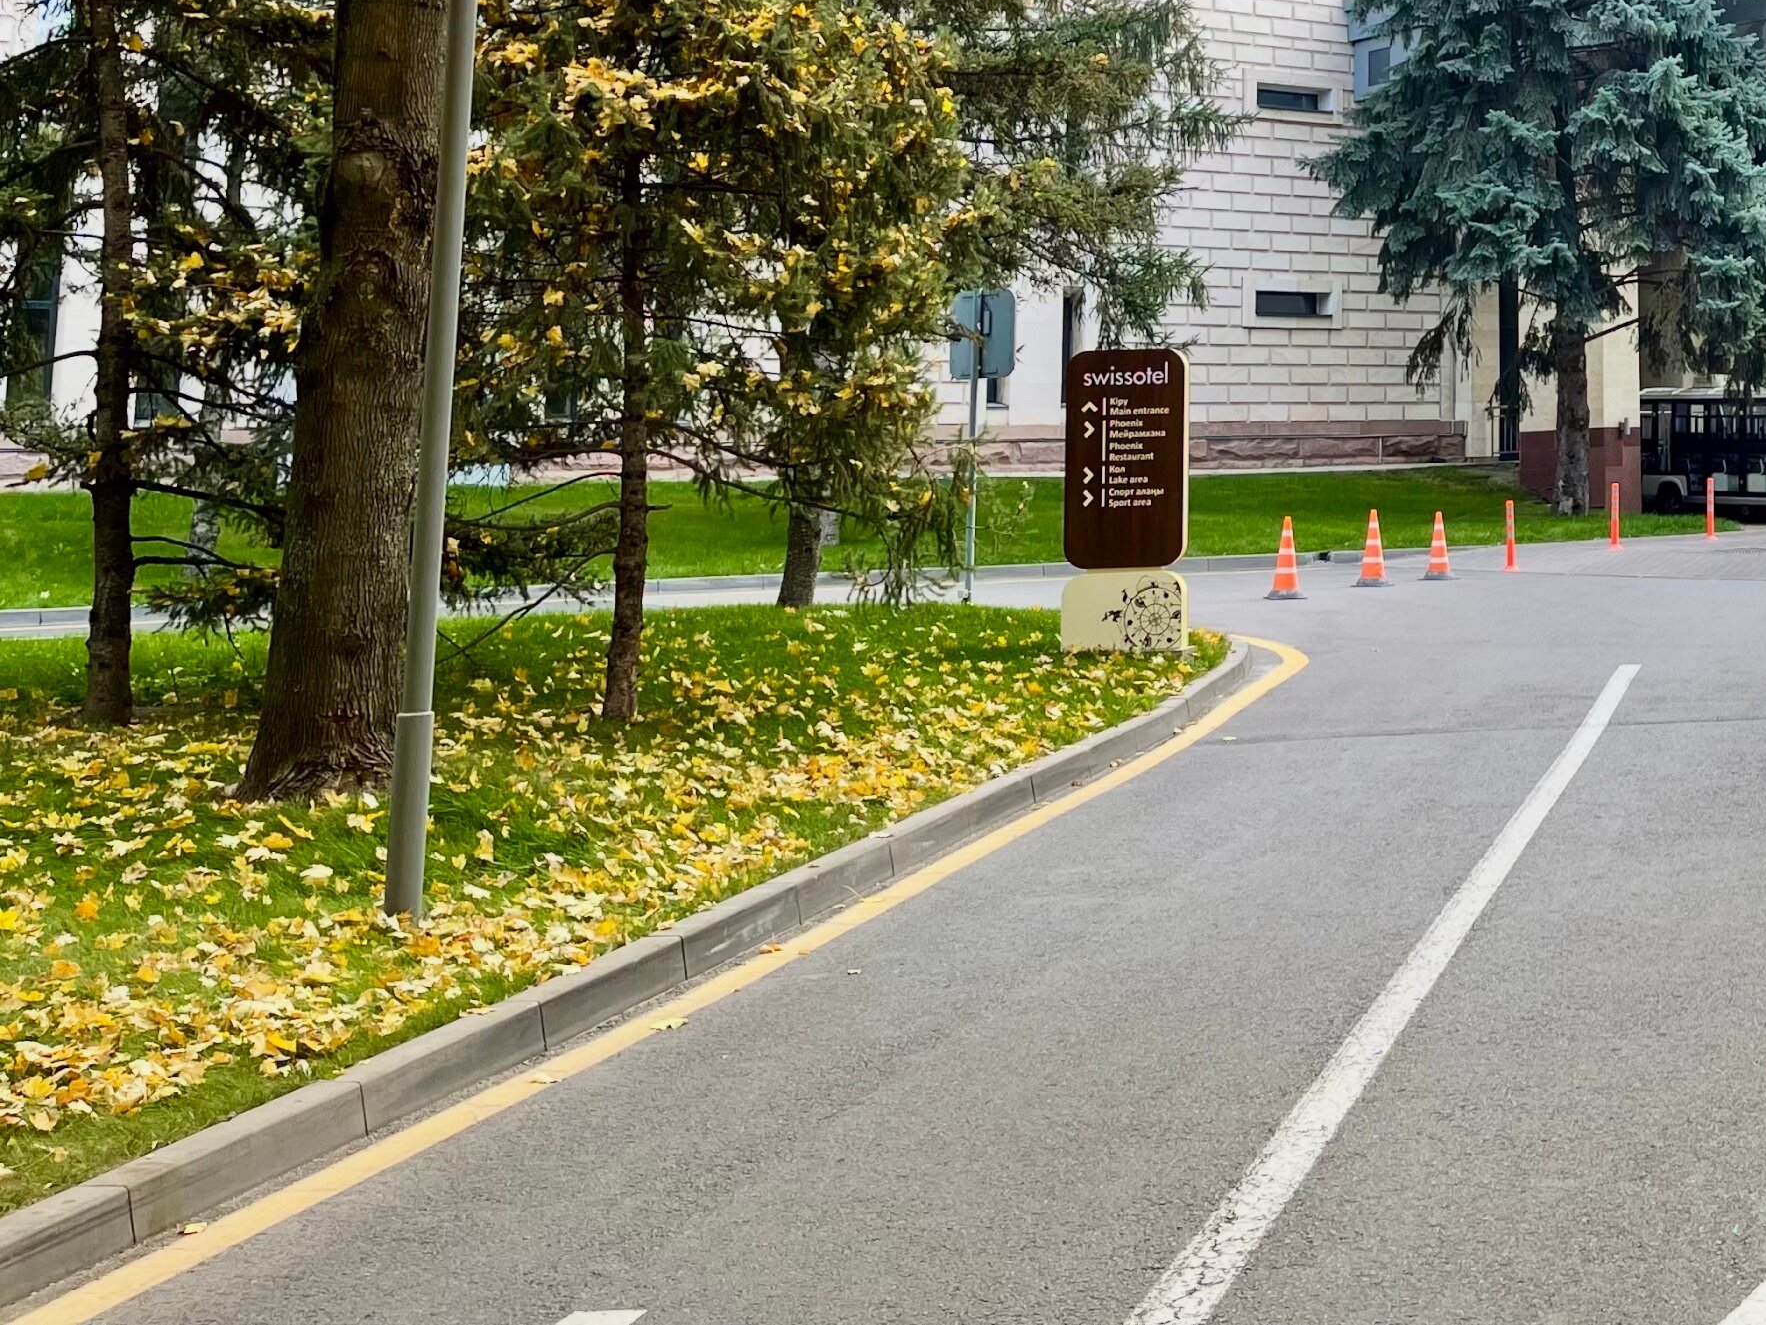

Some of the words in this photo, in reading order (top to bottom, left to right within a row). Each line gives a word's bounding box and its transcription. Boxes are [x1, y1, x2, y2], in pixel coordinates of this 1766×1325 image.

[1083, 360, 1169, 387] swissotel
[1109, 405, 1132, 416] Main
[1132, 406, 1170, 415] entrance
[1109, 418, 1144, 428] Phoenix
[1109, 441, 1144, 451] Phoenix
[1109, 452, 1155, 462] Restaurant
[1108, 475, 1128, 485] Lake
[1129, 476, 1149, 484] area
[1108, 487, 1135, 498] Спорт
[1108, 498, 1132, 509] Sport
[1132, 498, 1152, 507] area
